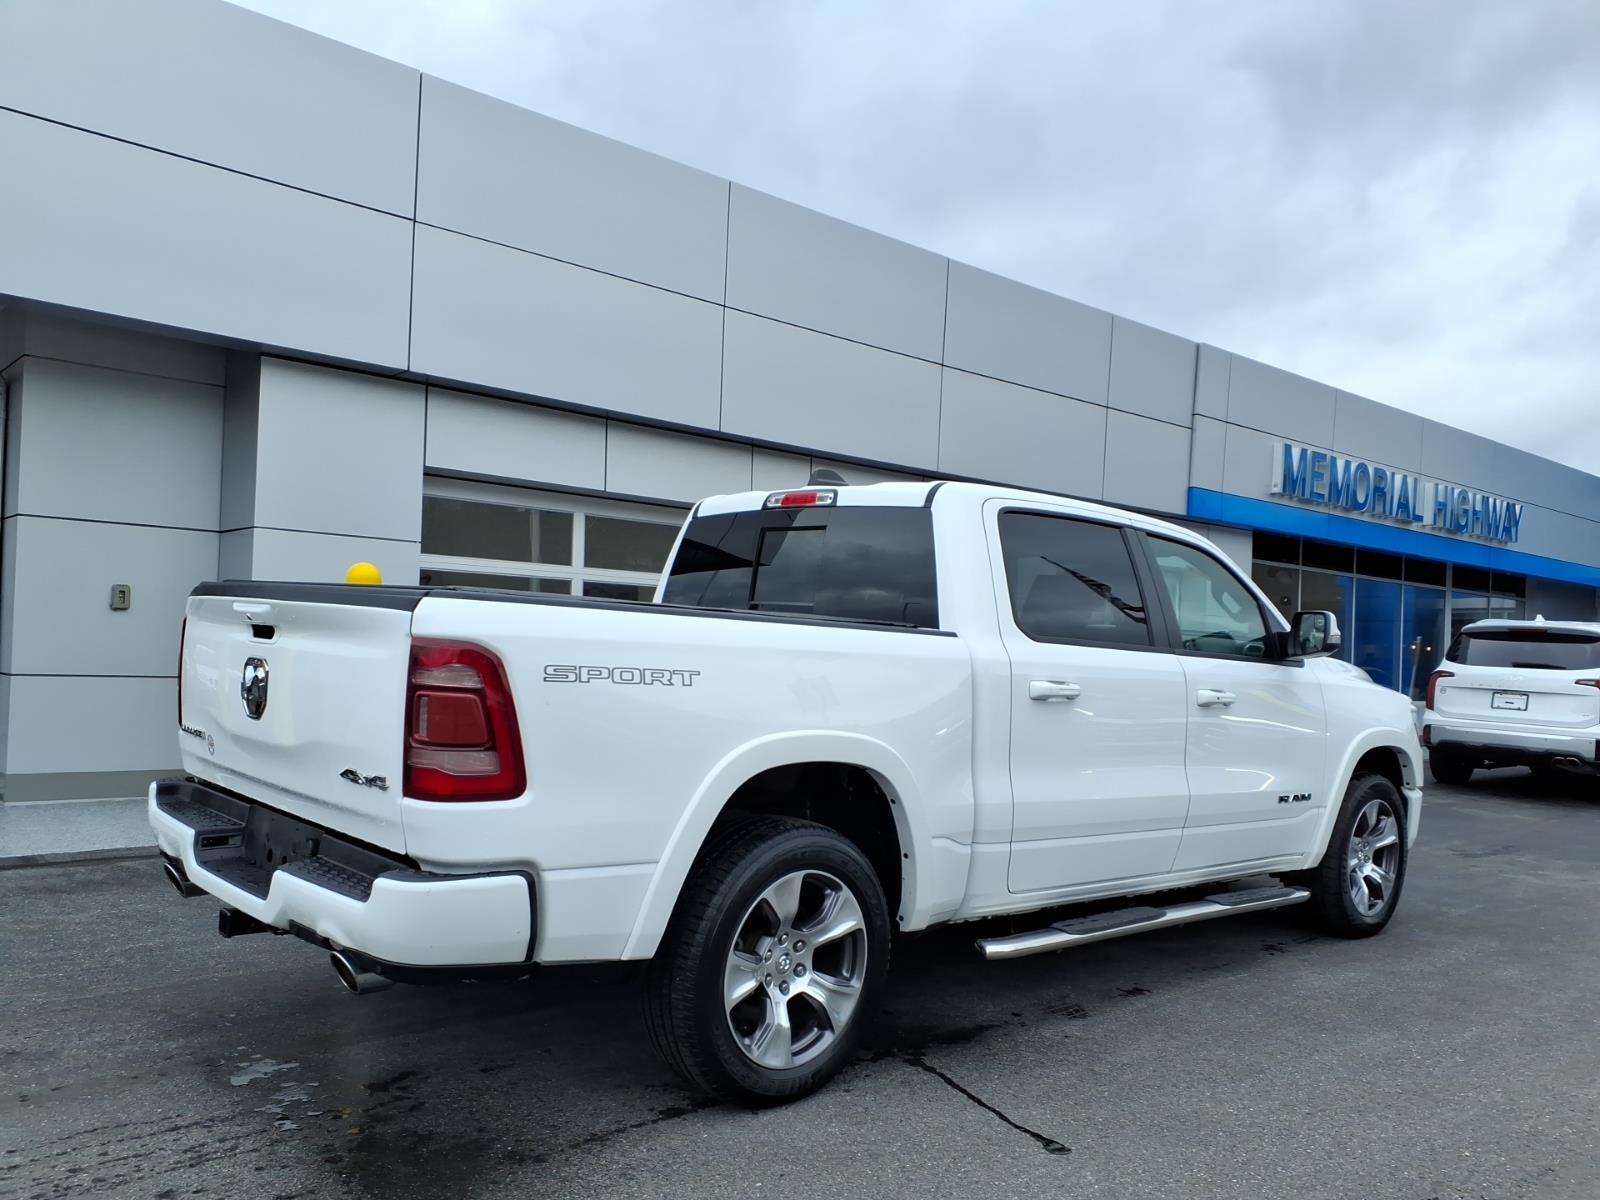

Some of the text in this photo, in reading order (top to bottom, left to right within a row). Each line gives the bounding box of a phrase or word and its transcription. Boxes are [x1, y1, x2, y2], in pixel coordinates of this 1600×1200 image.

[1279, 443, 1524, 543] MEMORIAL HIGHWAY
[543, 664, 701, 687] SPORT
[1278, 793, 1312, 804] RAM
